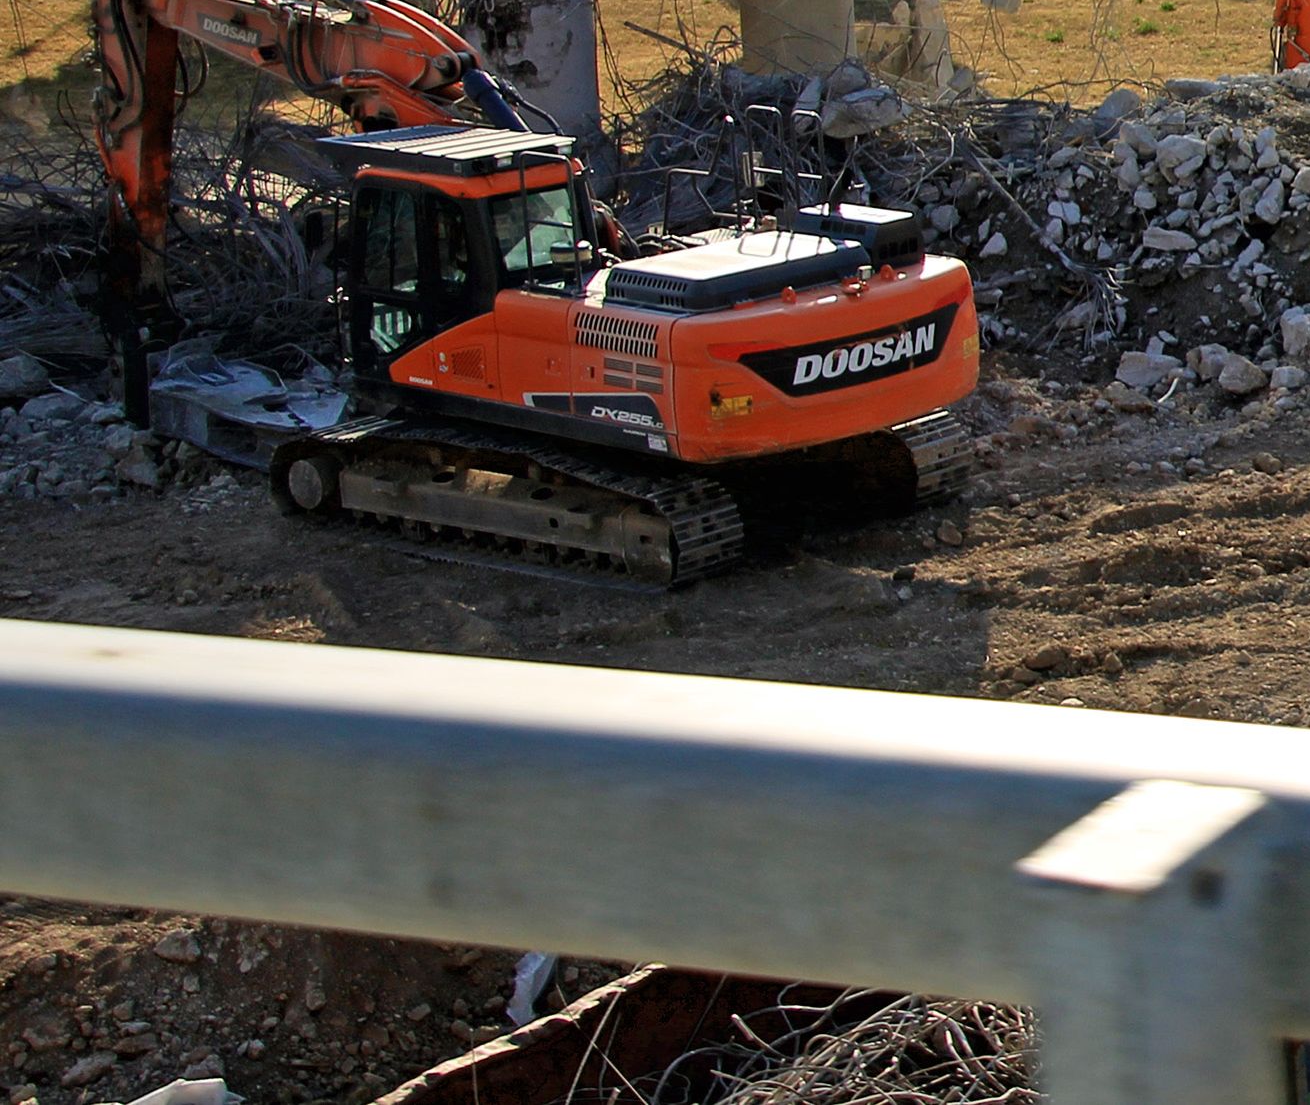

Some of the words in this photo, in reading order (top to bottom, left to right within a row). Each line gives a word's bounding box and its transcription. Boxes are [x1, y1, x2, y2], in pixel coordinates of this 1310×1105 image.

[203, 17, 258, 44] DOOSAN
[793, 323, 935, 385] DOOSAN
[591, 405, 664, 429] DX255LC
